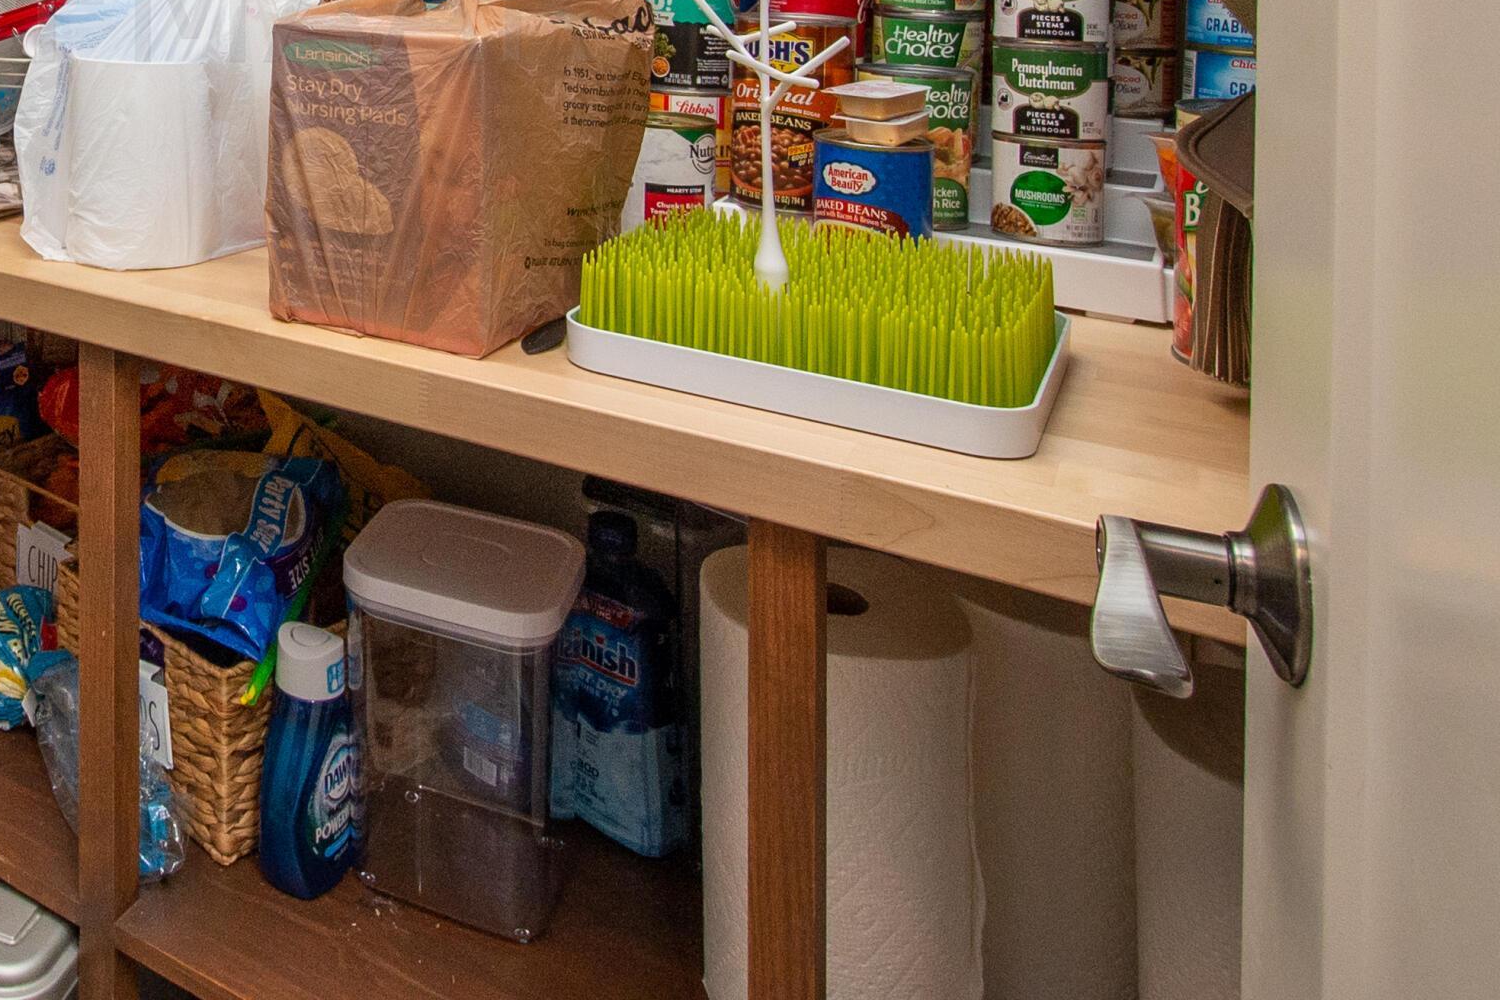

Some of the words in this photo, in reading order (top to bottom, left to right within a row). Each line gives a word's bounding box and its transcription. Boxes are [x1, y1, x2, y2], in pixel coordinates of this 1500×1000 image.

[1031, 14, 1061, 22] PIECES
[1063, 15, 1070, 23] &
[1036, 21, 1064, 29] STEMS
[893, 24, 960, 47] Healthy
[1025, 28, 1075, 37] MUSHROOMS
[295, 45, 371, 66] Lansinoh
[885, 38, 954, 58] Choice
[1011, 58, 1083, 77] Pennsylvania
[287, 74, 325, 97] Stay
[331, 78, 362, 101] Dry
[1018, 73, 1075, 91] Dutchman
[736, 82, 815, 106] Orinal
[926, 84, 970, 106] ealthy
[361, 104, 408, 127] Pads
[676, 100, 715, 115] Libby's
[1026, 110, 1056, 119] PIECES
[1058, 112, 1065, 120] &
[1020, 125, 1071, 135] MUSHROOMS
[1031, 118, 1059, 126] STEMS
[828, 166, 868, 180] American
[831, 177, 863, 192] Beauty
[942, 198, 960, 208] Rice
[1015, 188, 1065, 204] MUSHROOMS
[816, 199, 844, 211] BAKED
[847, 202, 888, 221] BEANS
